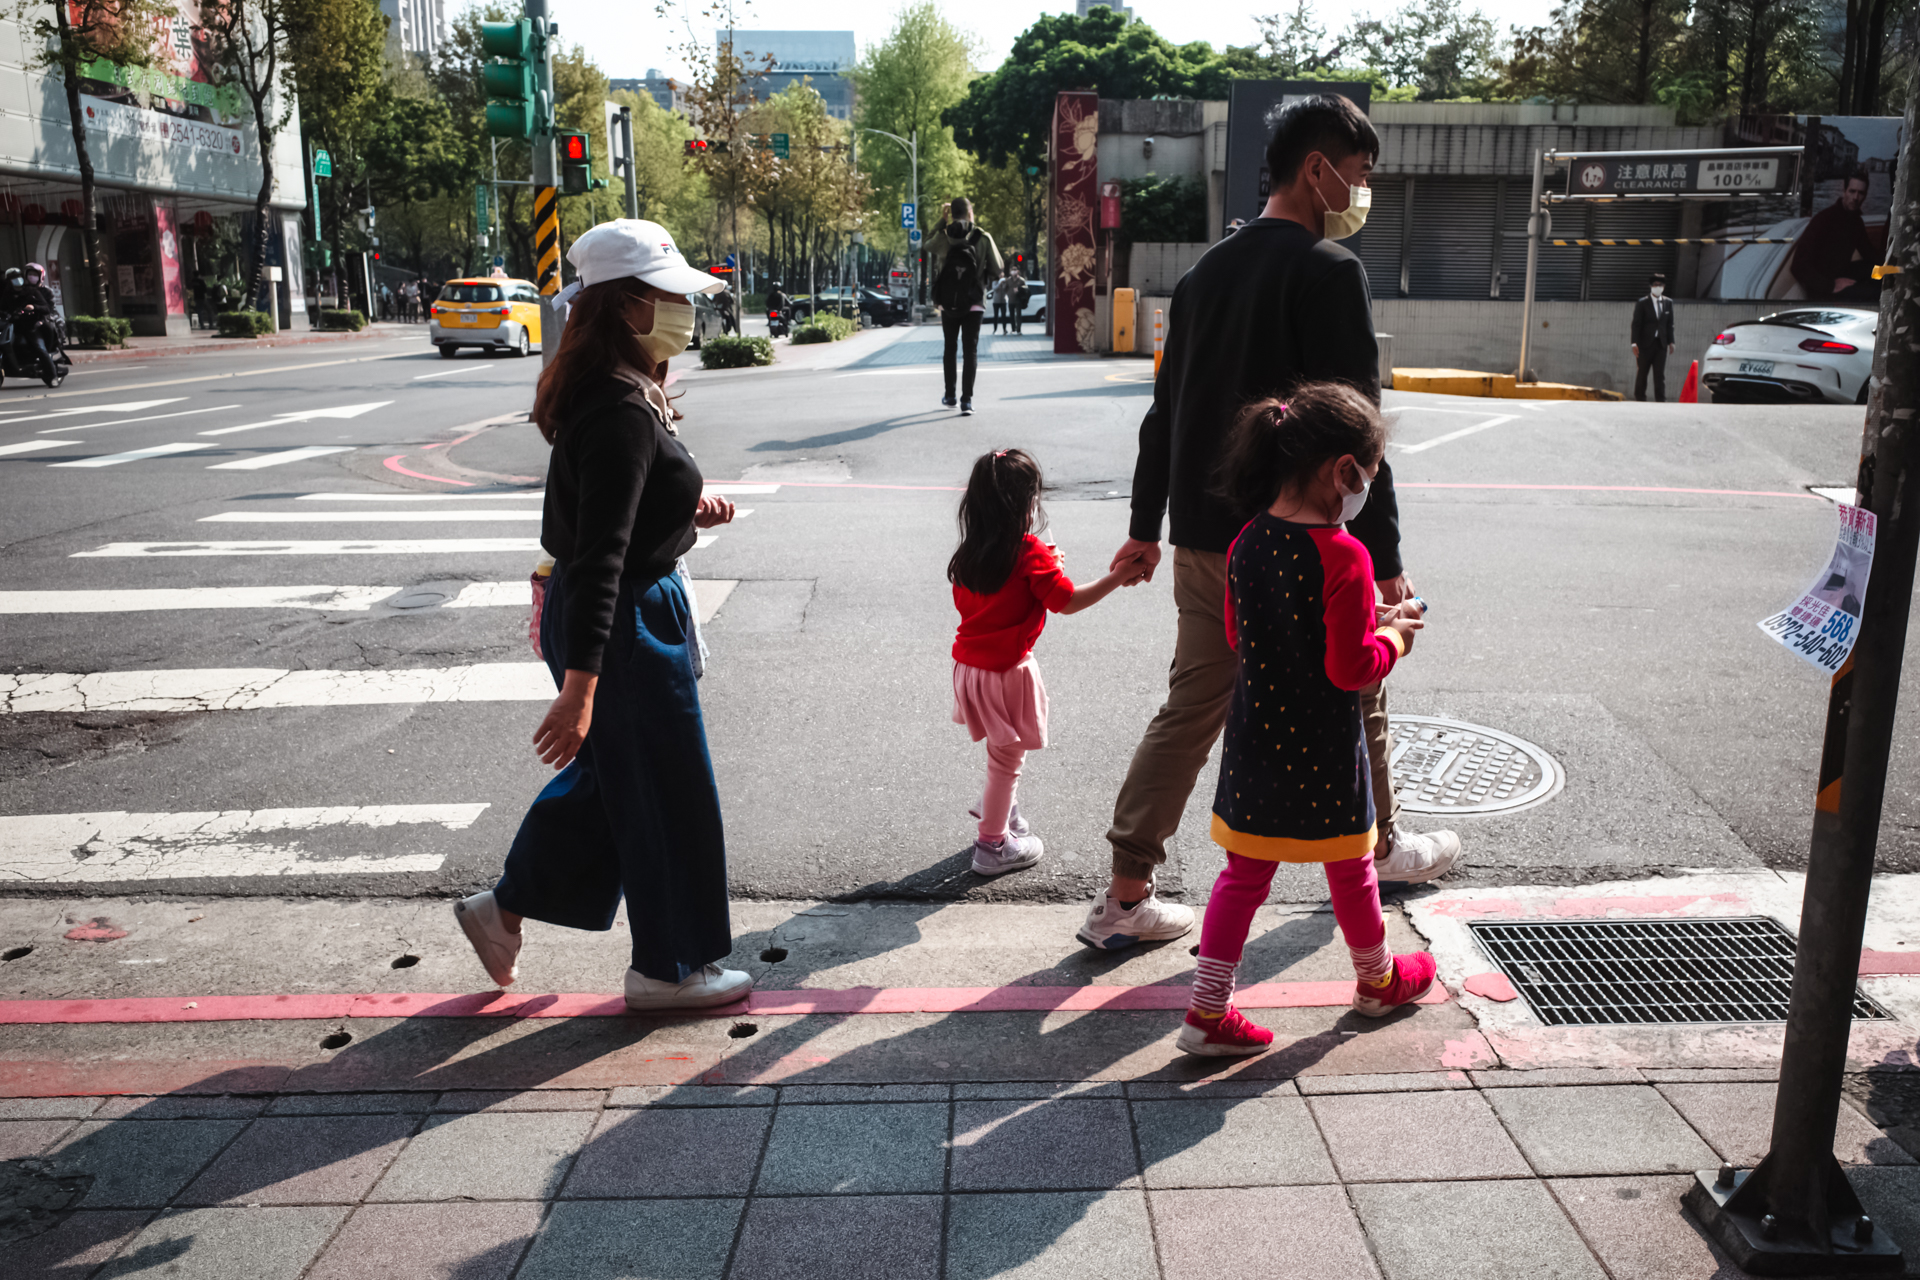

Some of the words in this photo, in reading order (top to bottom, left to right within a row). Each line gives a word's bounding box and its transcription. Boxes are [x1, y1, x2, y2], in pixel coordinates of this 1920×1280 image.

[170, 122, 224, 151] 2541-6320
[1617, 163, 1688, 179] 注意限高
[1707, 161, 1769, 171] 晶華酒店停車場
[1613, 180, 1688, 189] CLEARANCE
[1838, 504, 1875, 537] 恭賀新禧
[1788, 605, 1823, 629] 雙捷運
[1798, 595, 1831, 618] 採光佳
[1821, 610, 1854, 642] 568
[1763, 613, 1848, 671] 0972-540-602
